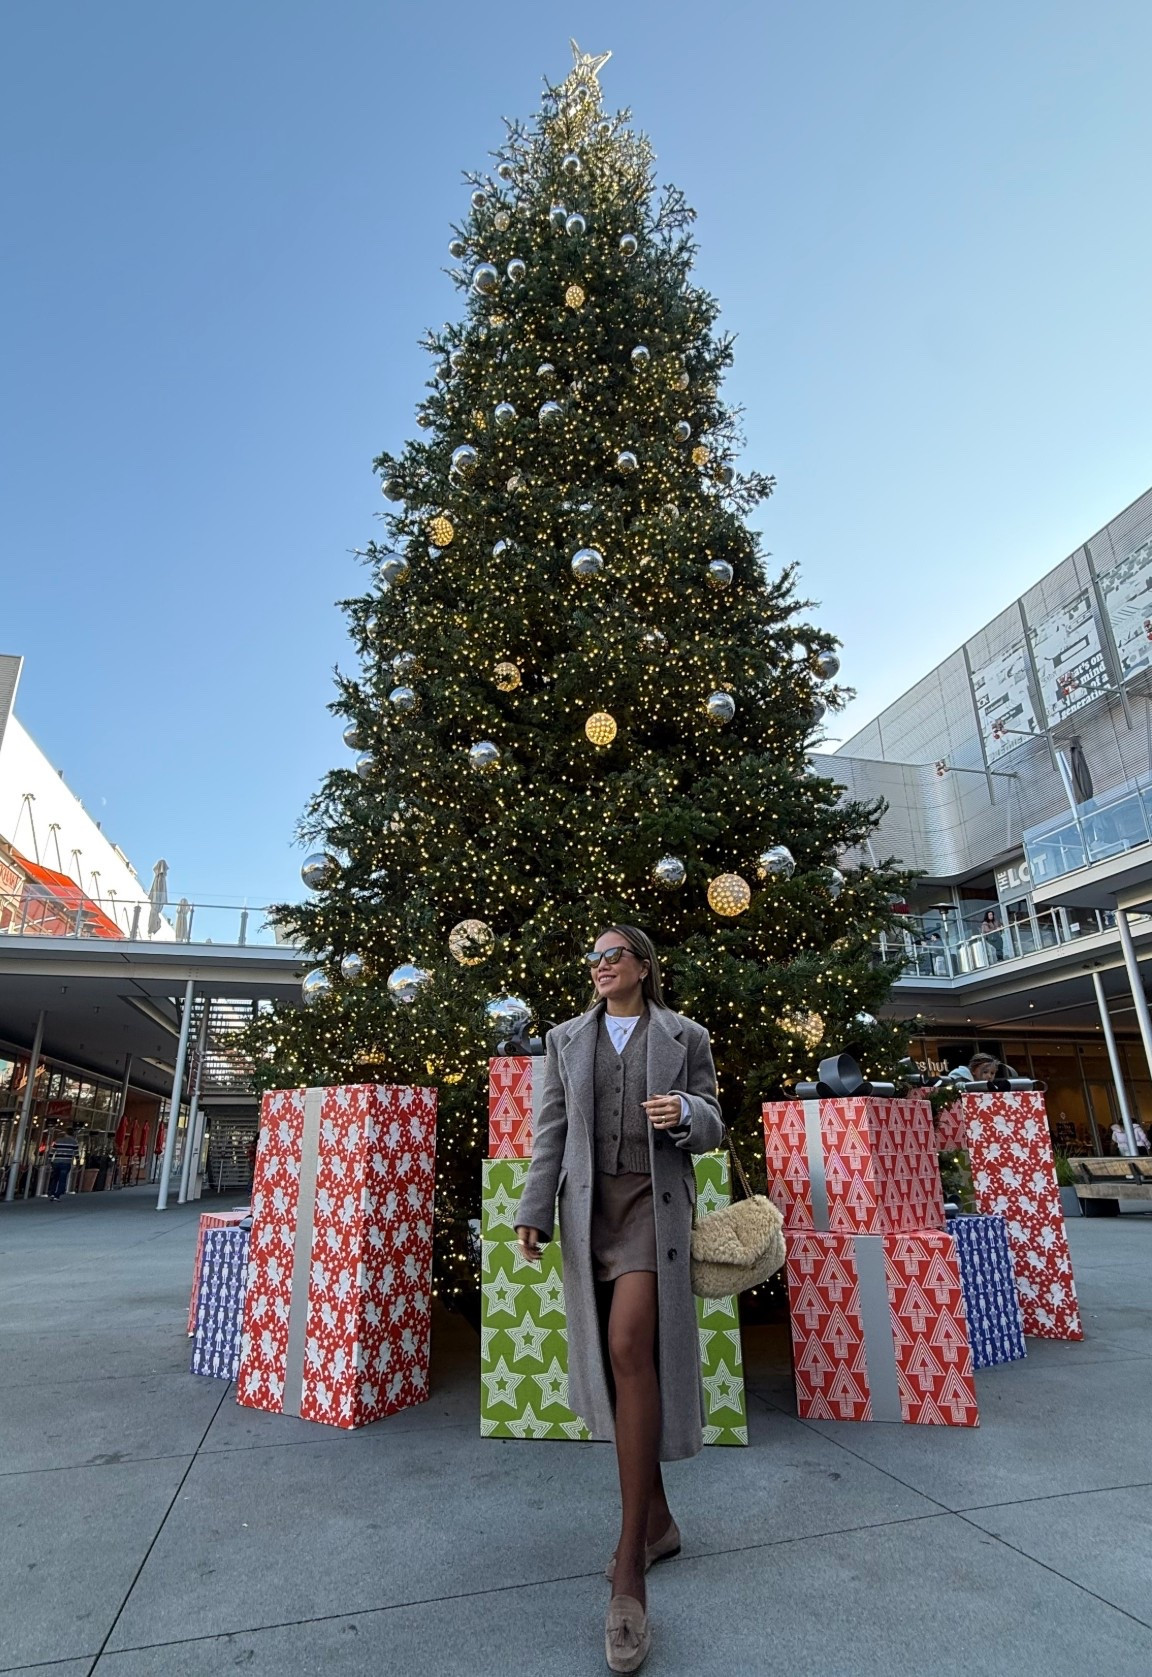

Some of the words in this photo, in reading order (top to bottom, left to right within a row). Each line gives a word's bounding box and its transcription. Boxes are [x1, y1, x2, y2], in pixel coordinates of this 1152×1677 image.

[1090, 652, 1104, 666] on
[1080, 660, 1106, 684] mind
[997, 871, 1009, 892] THE
[1007, 853, 1047, 888] LOT
[928, 1057, 949, 1072] hut
